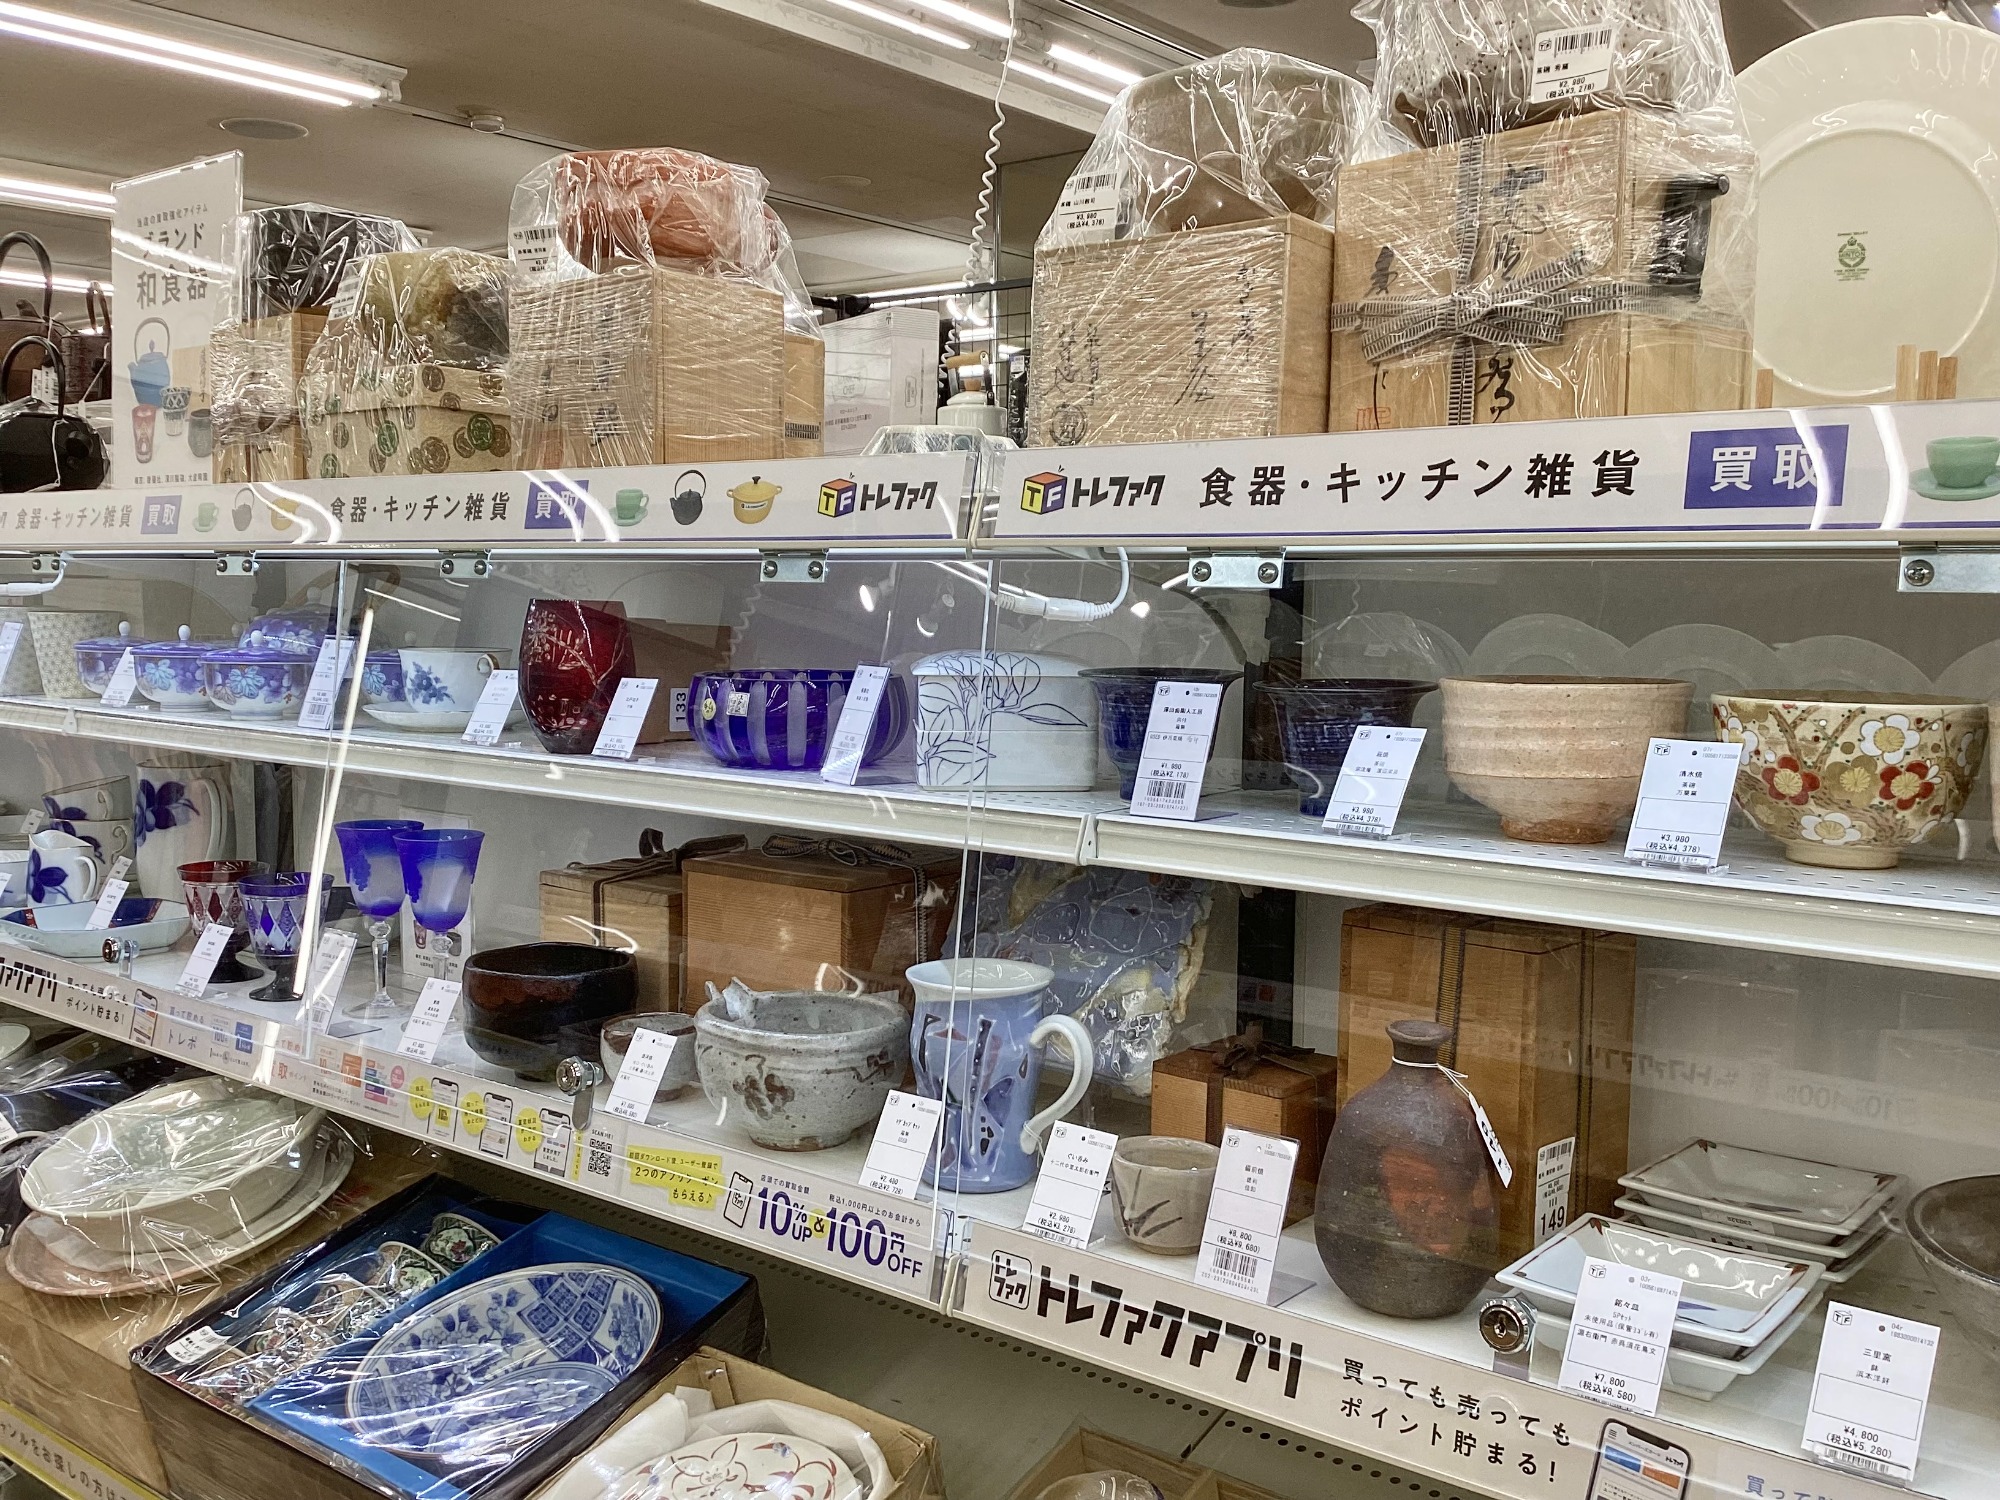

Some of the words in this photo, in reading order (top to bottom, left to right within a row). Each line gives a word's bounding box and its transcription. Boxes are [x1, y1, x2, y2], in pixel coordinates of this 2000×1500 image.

[137, 264, 208, 310] 和食器
[1199, 448, 1641, 509] 食器・キッチン雑貨
[1708, 443, 1821, 493] 買取
[860, 481, 939, 512] トレファク
[1072, 474, 1166, 508] トレファク
[15, 504, 133, 530] 食器・キッチン雑貨
[147, 504, 175, 526] 買取
[330, 491, 511, 523] 食器・キッチン雑貨
[535, 491, 580, 520] 買取
[675, 692, 687, 723] 133
[1645, 841, 1701, 853] (税込¥4,378)
[1661, 833, 1690, 843] ¥3,980
[66, 997, 125, 1025] ポイント貯まる!
[792, 1223, 812, 1242] UP
[813, 1216, 825, 1233] &
[1541, 1205, 1565, 1236] 149
[1217, 1236, 1261, 1253] (税込¥9,680)
[888, 1253, 923, 1278] OFF
[1614, 1299, 1639, 1312] 銘々皿
[1037, 1265, 1303, 1399] トレファクアプリ
[1891, 1323, 1903, 1331] 04r
[1578, 1380, 1637, 1403] (税込¥8,580)
[1594, 1372, 1626, 1388] ¥7,800
[1342, 1357, 1571, 1448] 買っても売っても
[1340, 1397, 1557, 1483] ポイント貯まる!
[1826, 1432, 1892, 1459] (税込¥5,280)
[1844, 1425, 1879, 1443] ¥4,800
